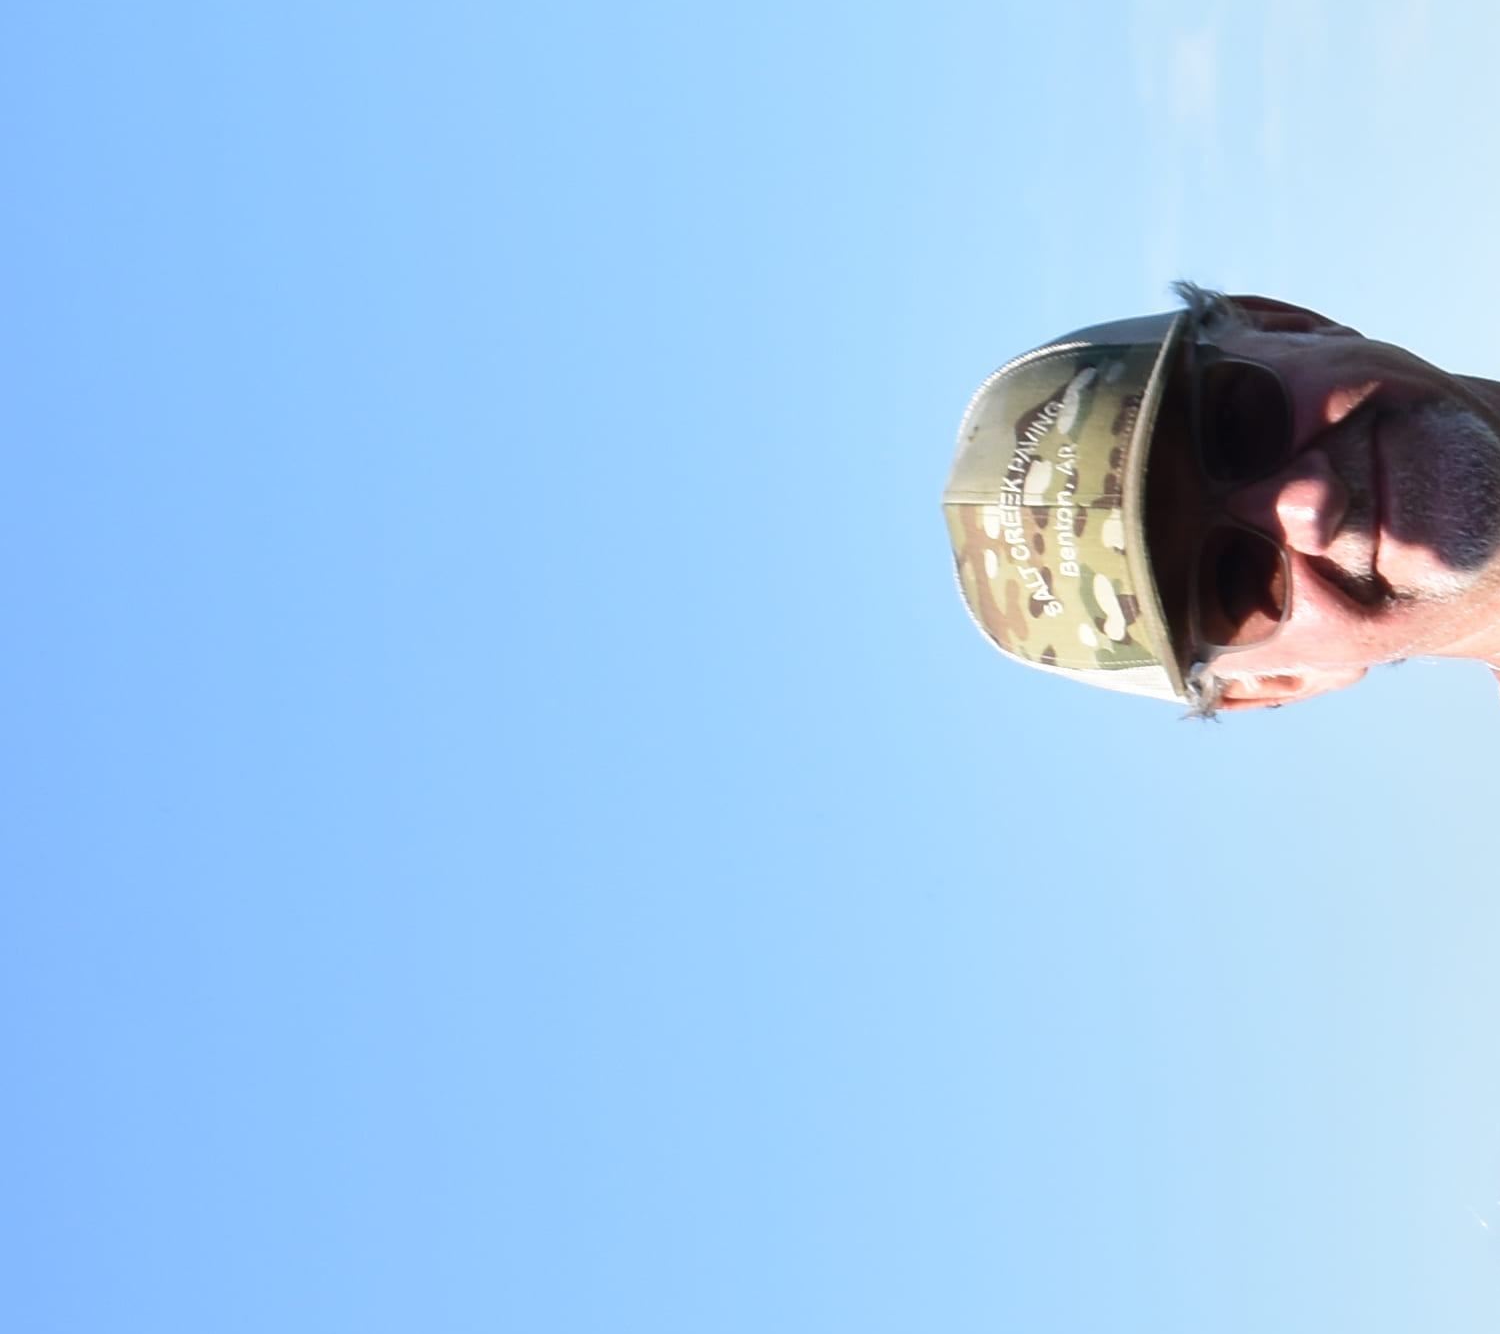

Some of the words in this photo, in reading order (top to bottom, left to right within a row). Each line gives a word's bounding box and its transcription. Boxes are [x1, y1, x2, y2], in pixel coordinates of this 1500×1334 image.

[1007, 402, 1065, 473] PAVING
[998, 476, 1031, 561] CREEK
[1055, 483, 1080, 577] Benton,
[1015, 565, 1064, 617] SALT
